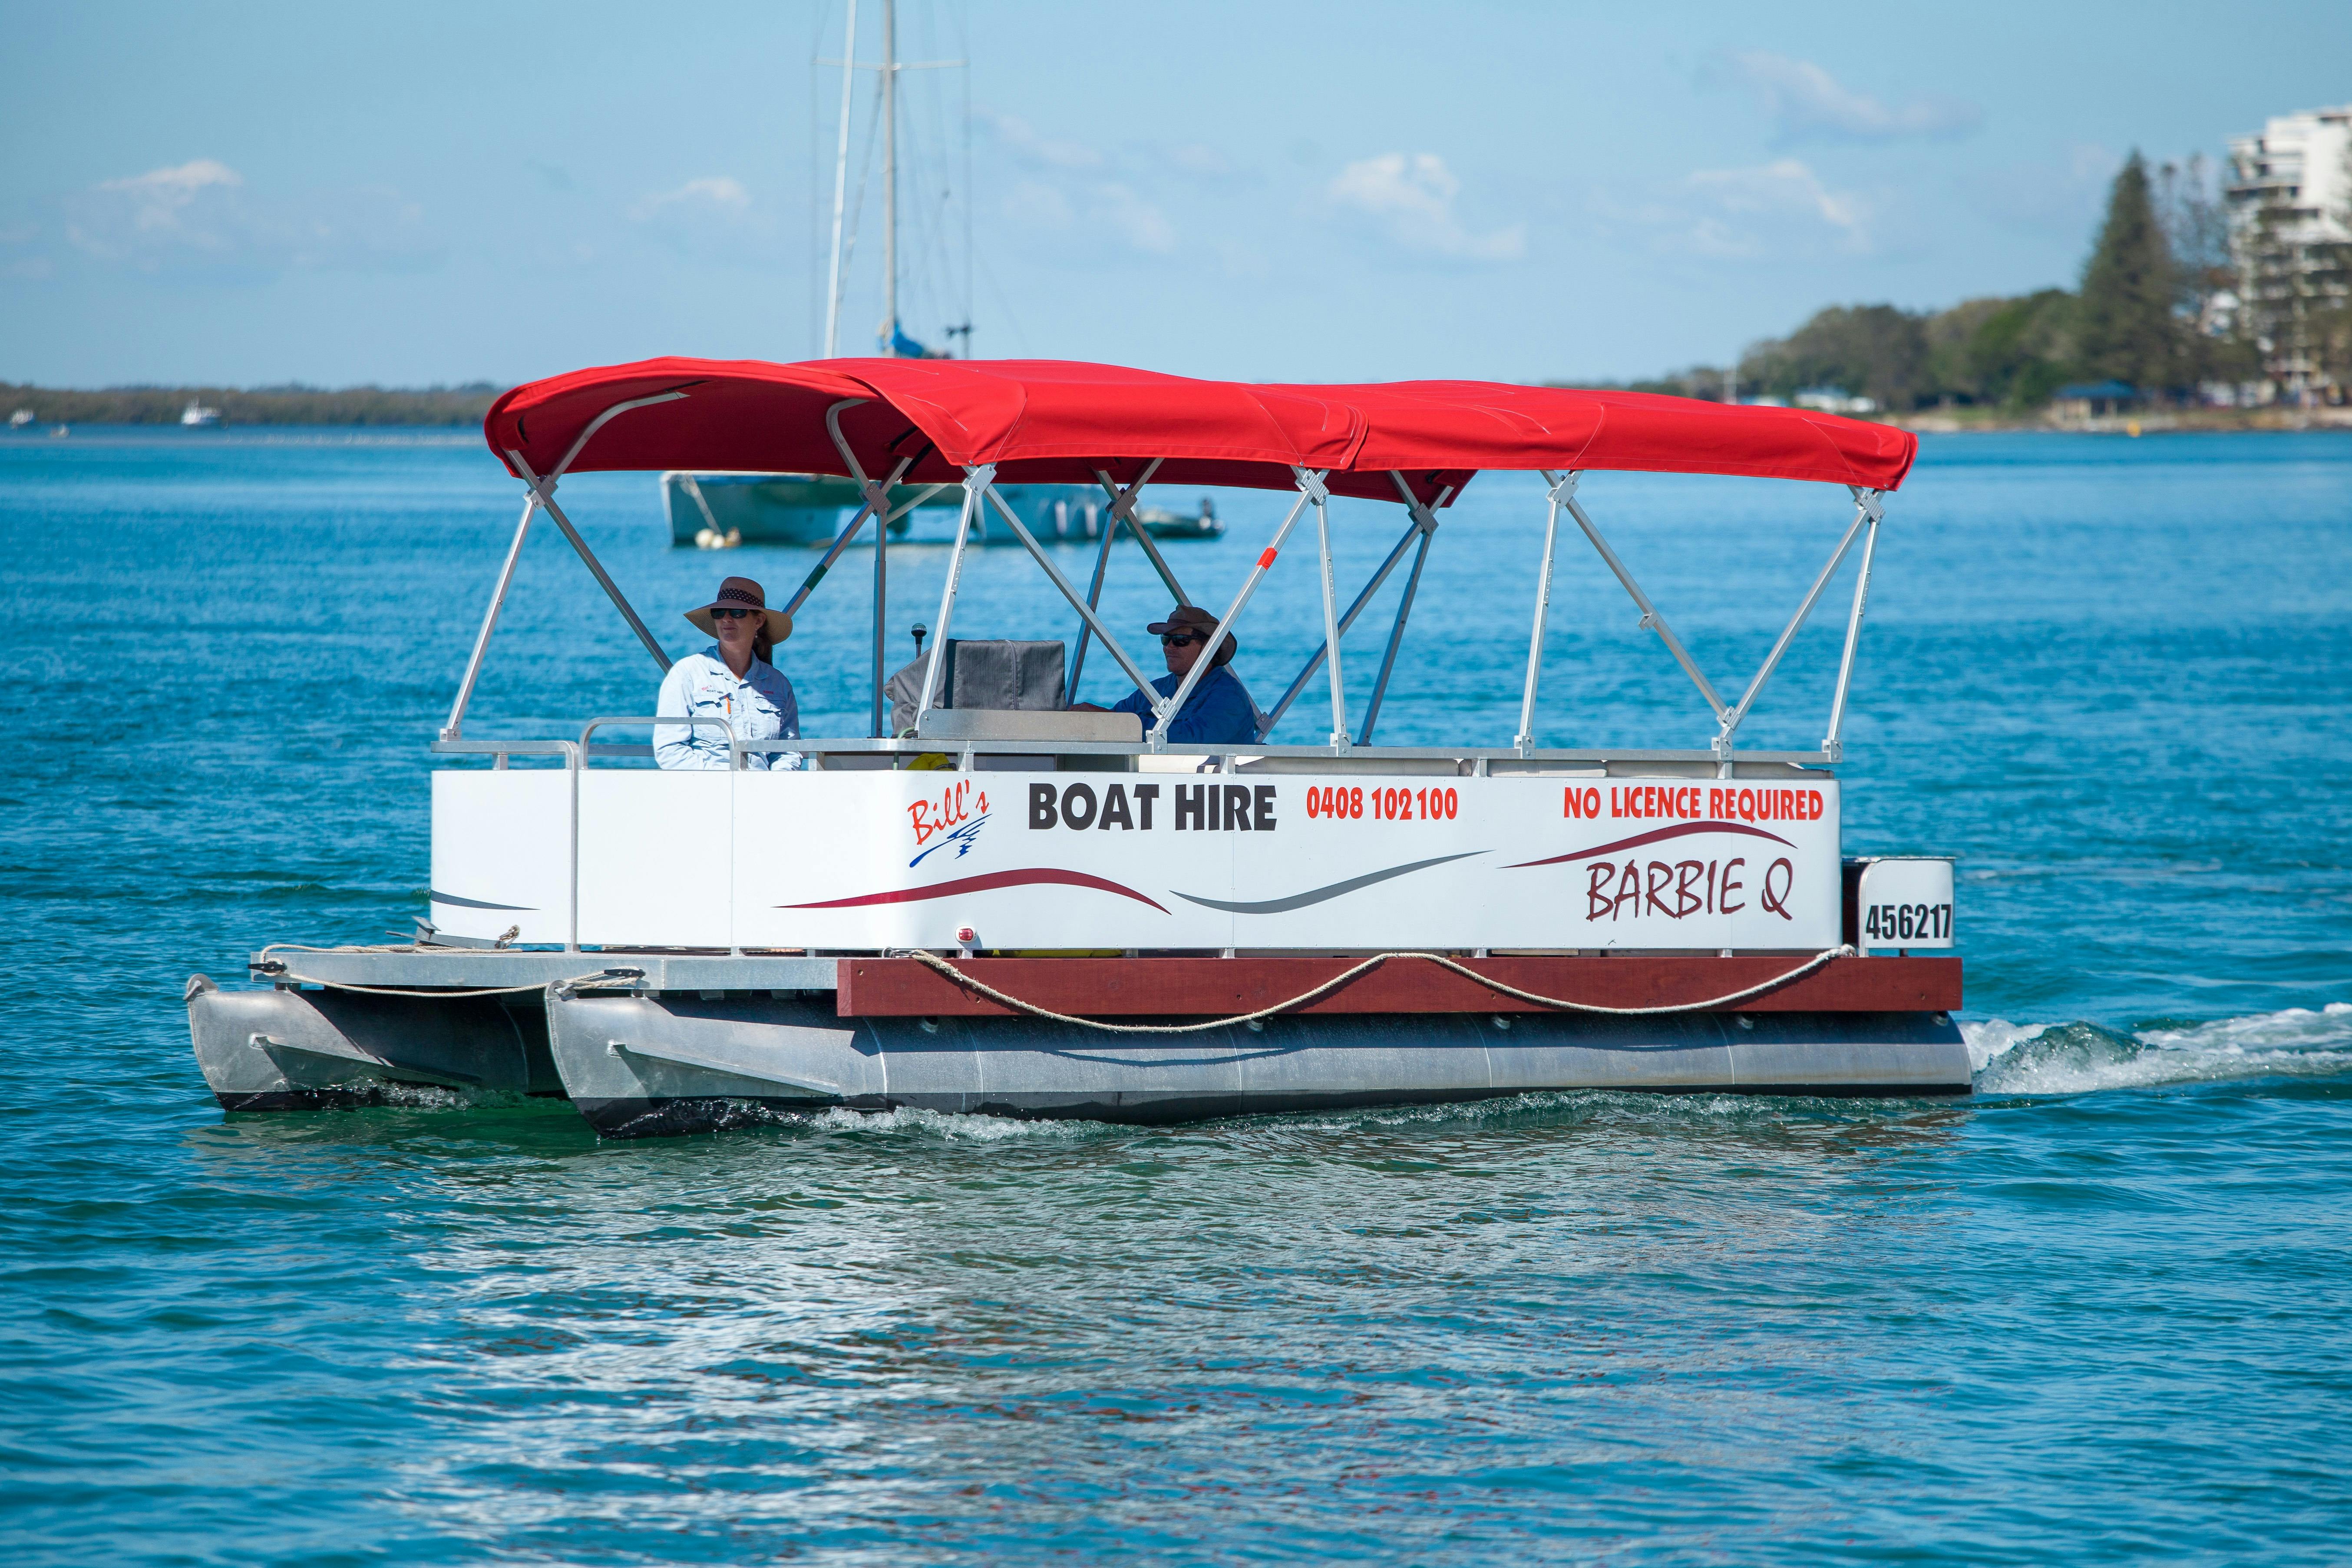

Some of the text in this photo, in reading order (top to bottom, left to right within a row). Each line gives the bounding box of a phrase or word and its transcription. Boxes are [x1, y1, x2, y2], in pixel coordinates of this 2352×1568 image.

[908, 779, 990, 845] Bill's
[1029, 782, 1278, 831] BOAT HIRE
[1307, 786, 1363, 819] 0408
[1564, 786, 1823, 824] NO LICENCE REQUIRED
[1586, 858, 1793, 921] BARBIE Q
[1866, 904, 1952, 940] 456217
